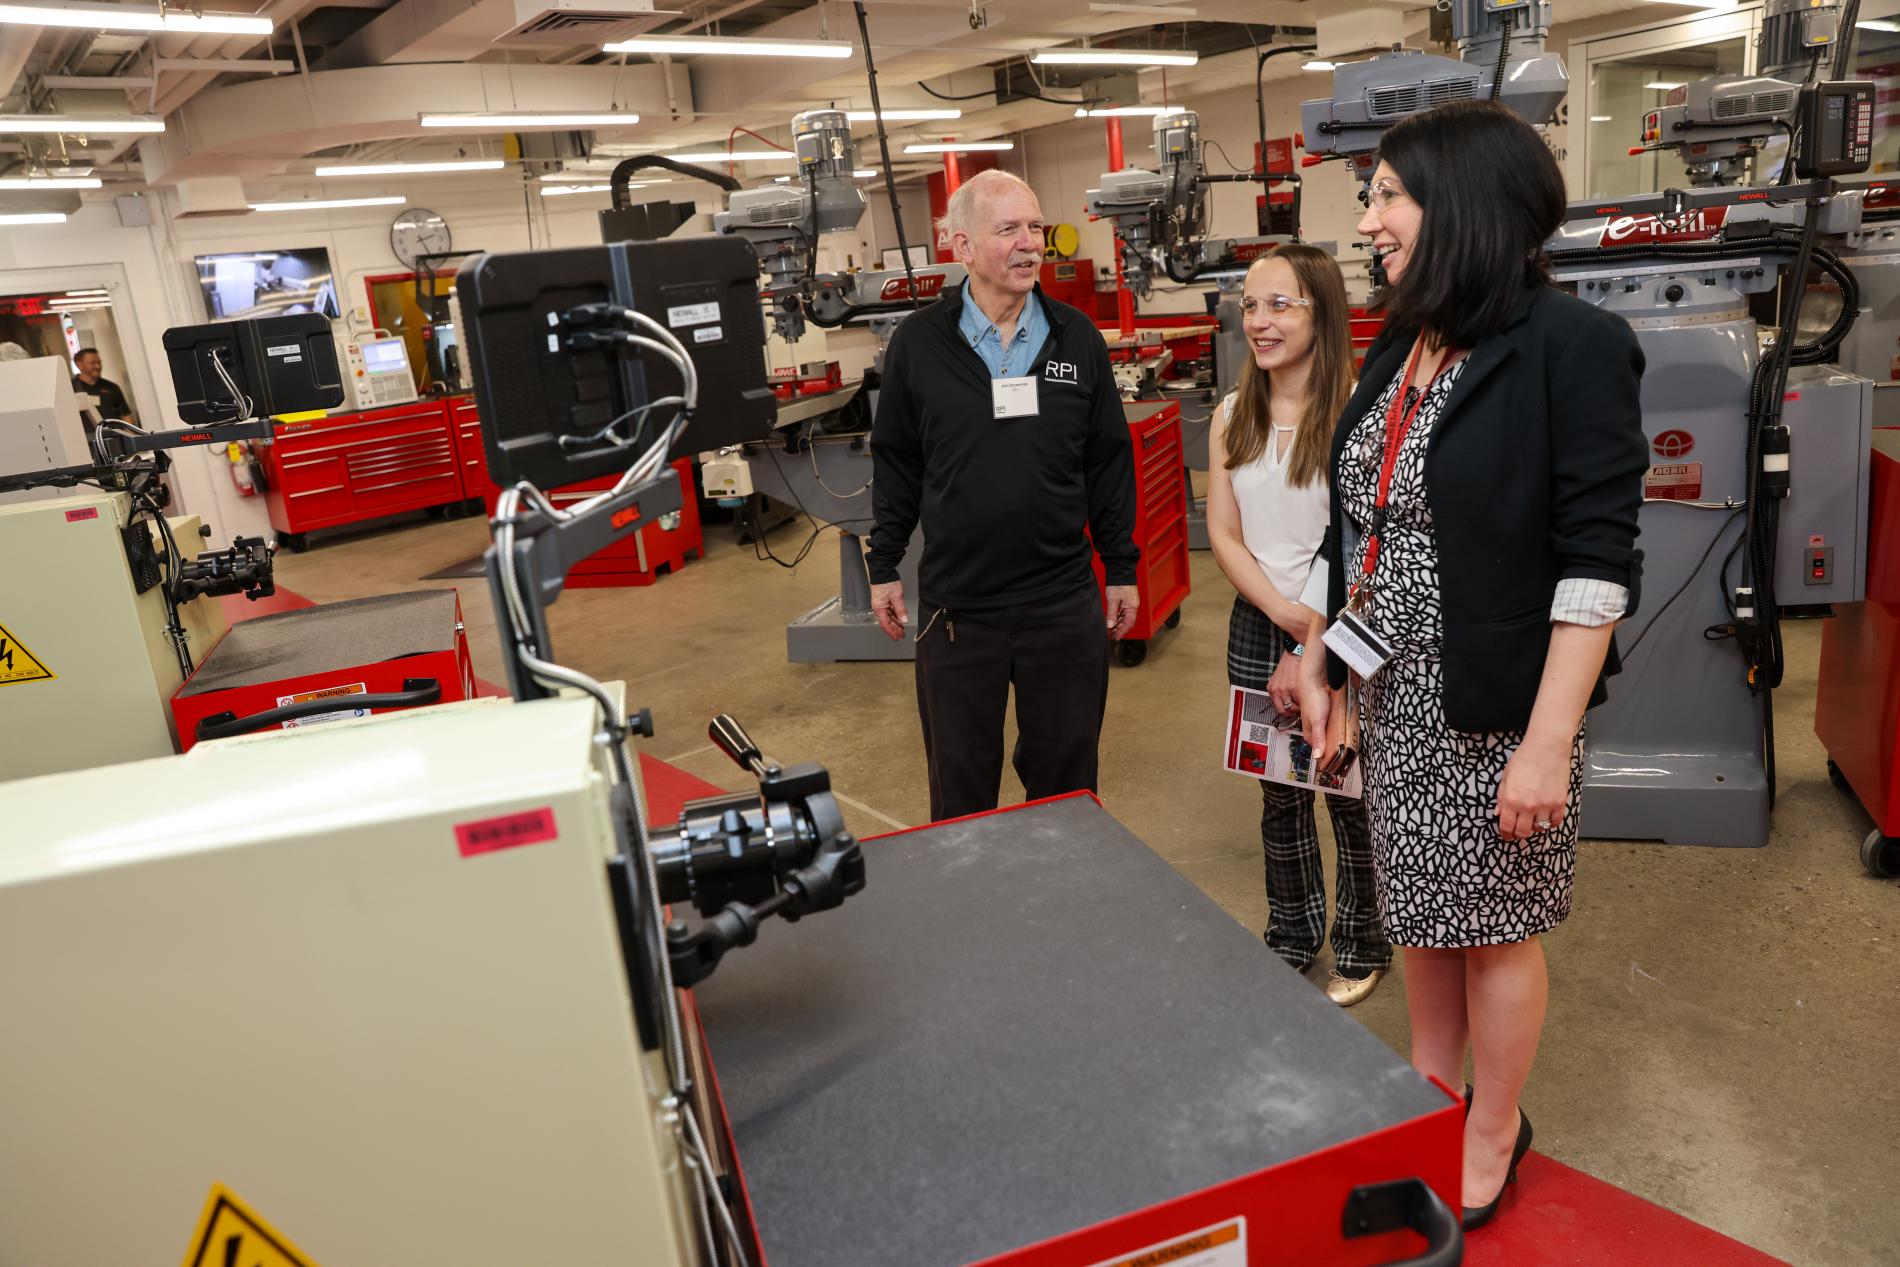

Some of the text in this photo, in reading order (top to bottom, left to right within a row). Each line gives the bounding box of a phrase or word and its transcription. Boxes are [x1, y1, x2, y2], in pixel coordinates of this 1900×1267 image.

[1739, 192, 1770, 201] NEWALL
[1596, 206, 1623, 214] NEWALL
[1608, 212, 1705, 240] e-mill
[1045, 360, 1078, 380] RPI
[181, 432, 212, 442] NEWALL
[315, 687, 351, 700] WARNING
